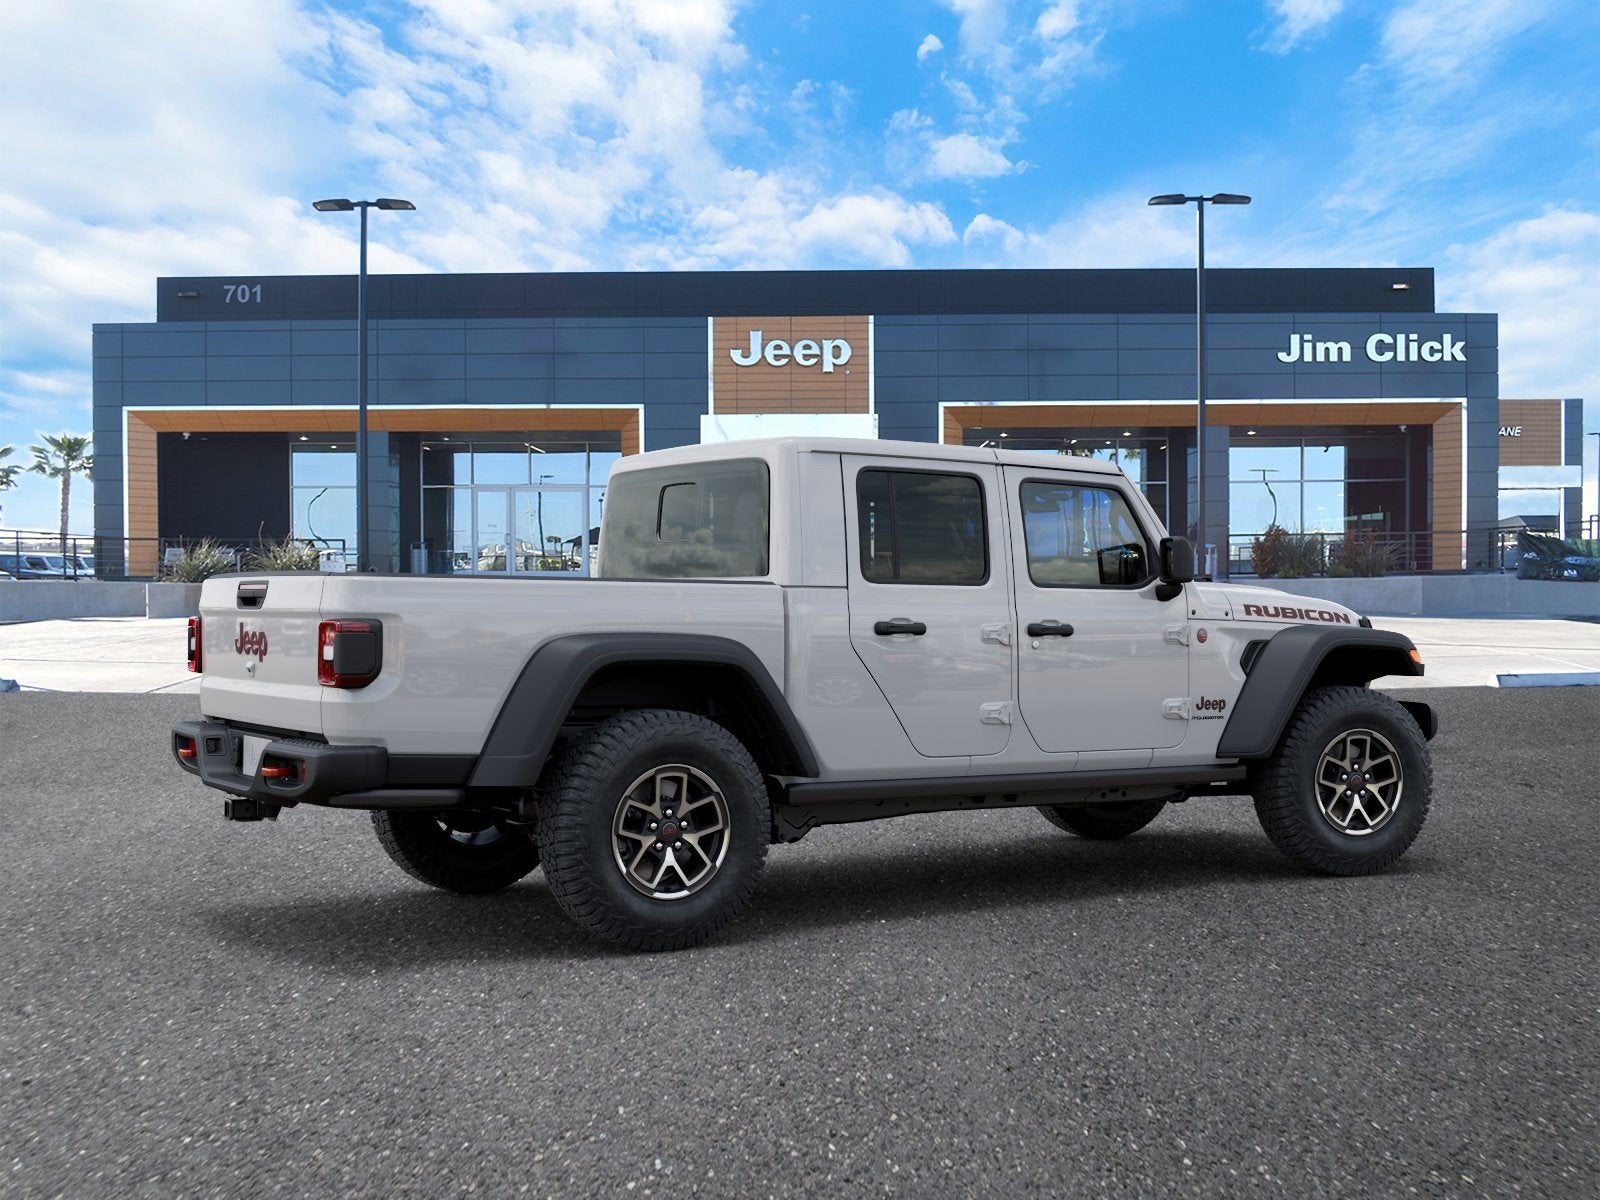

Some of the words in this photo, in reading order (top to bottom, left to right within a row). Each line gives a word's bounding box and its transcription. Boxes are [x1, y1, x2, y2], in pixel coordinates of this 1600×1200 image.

[223, 284, 262, 304] 701
[729, 329, 852, 374] Jeep
[1277, 333, 1352, 363] Jim
[1365, 333, 1467, 363] Click
[1243, 603, 1351, 625] RUBICON
[234, 621, 268, 663] Jeep
[1195, 695, 1227, 713] Jeep
